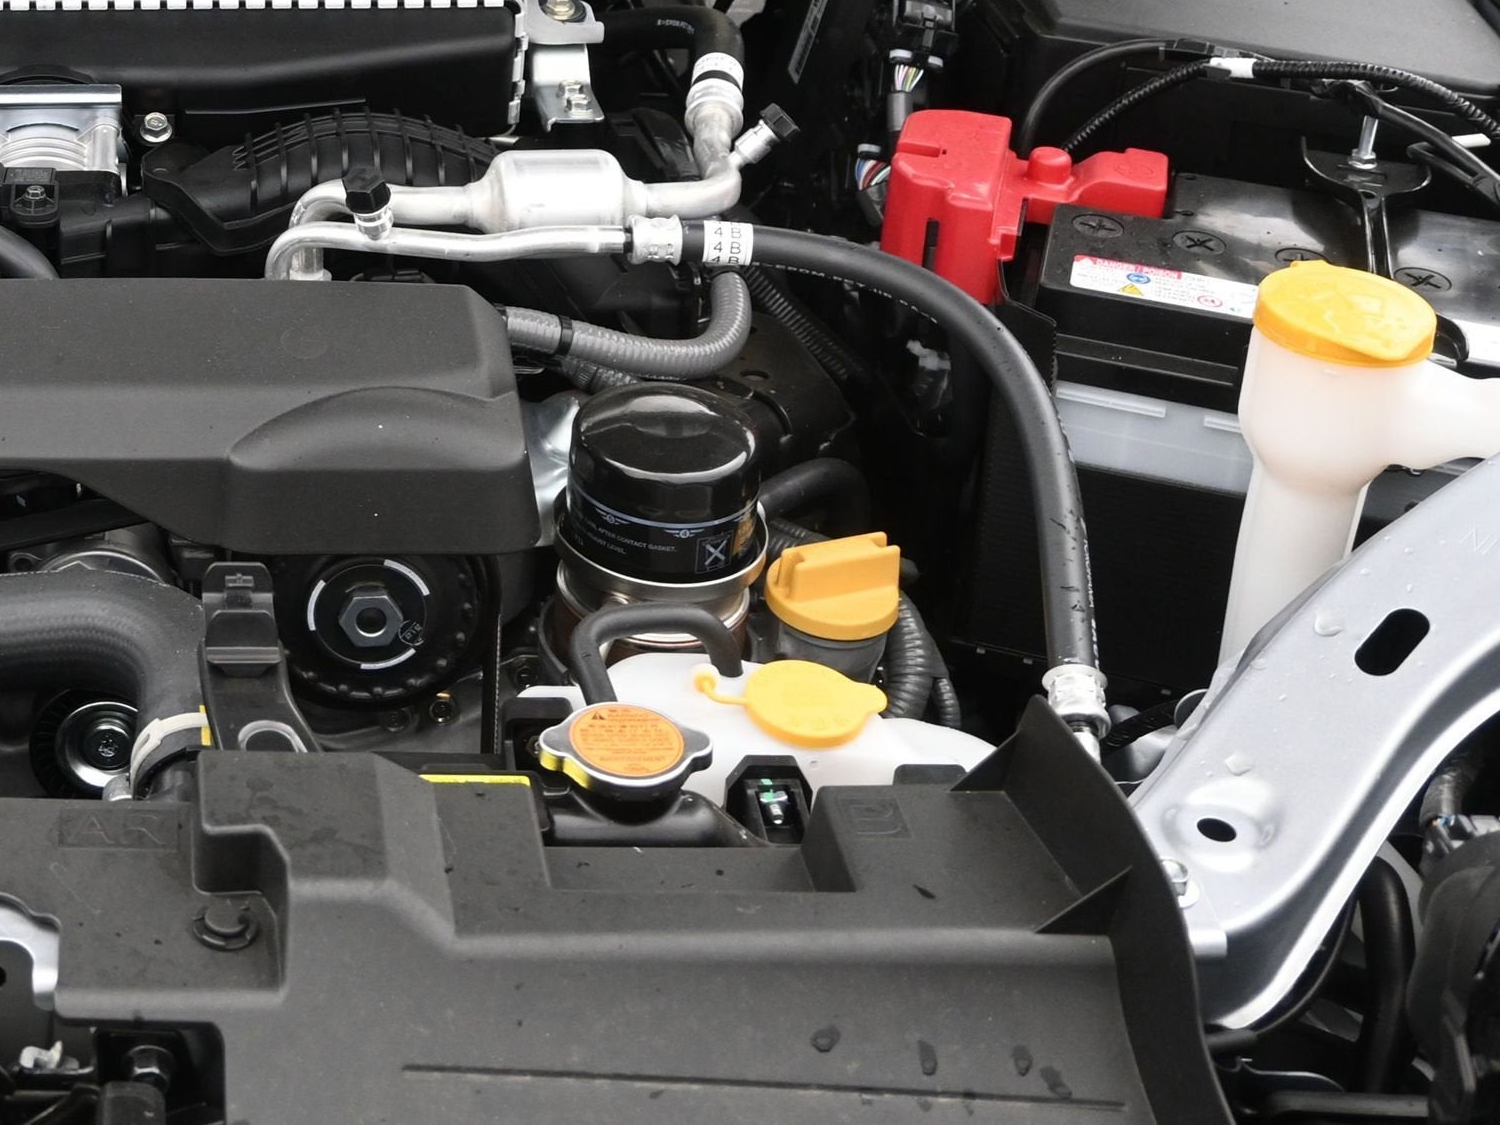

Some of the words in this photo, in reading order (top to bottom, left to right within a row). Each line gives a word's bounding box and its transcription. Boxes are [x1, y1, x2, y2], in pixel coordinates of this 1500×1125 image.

[713, 226, 724, 238] 4
[731, 227, 742, 239] B
[712, 241, 723, 253] 4
[730, 242, 741, 254] B
[598, 527, 616, 539] AFTER
[617, 535, 647, 548] CONTACT
